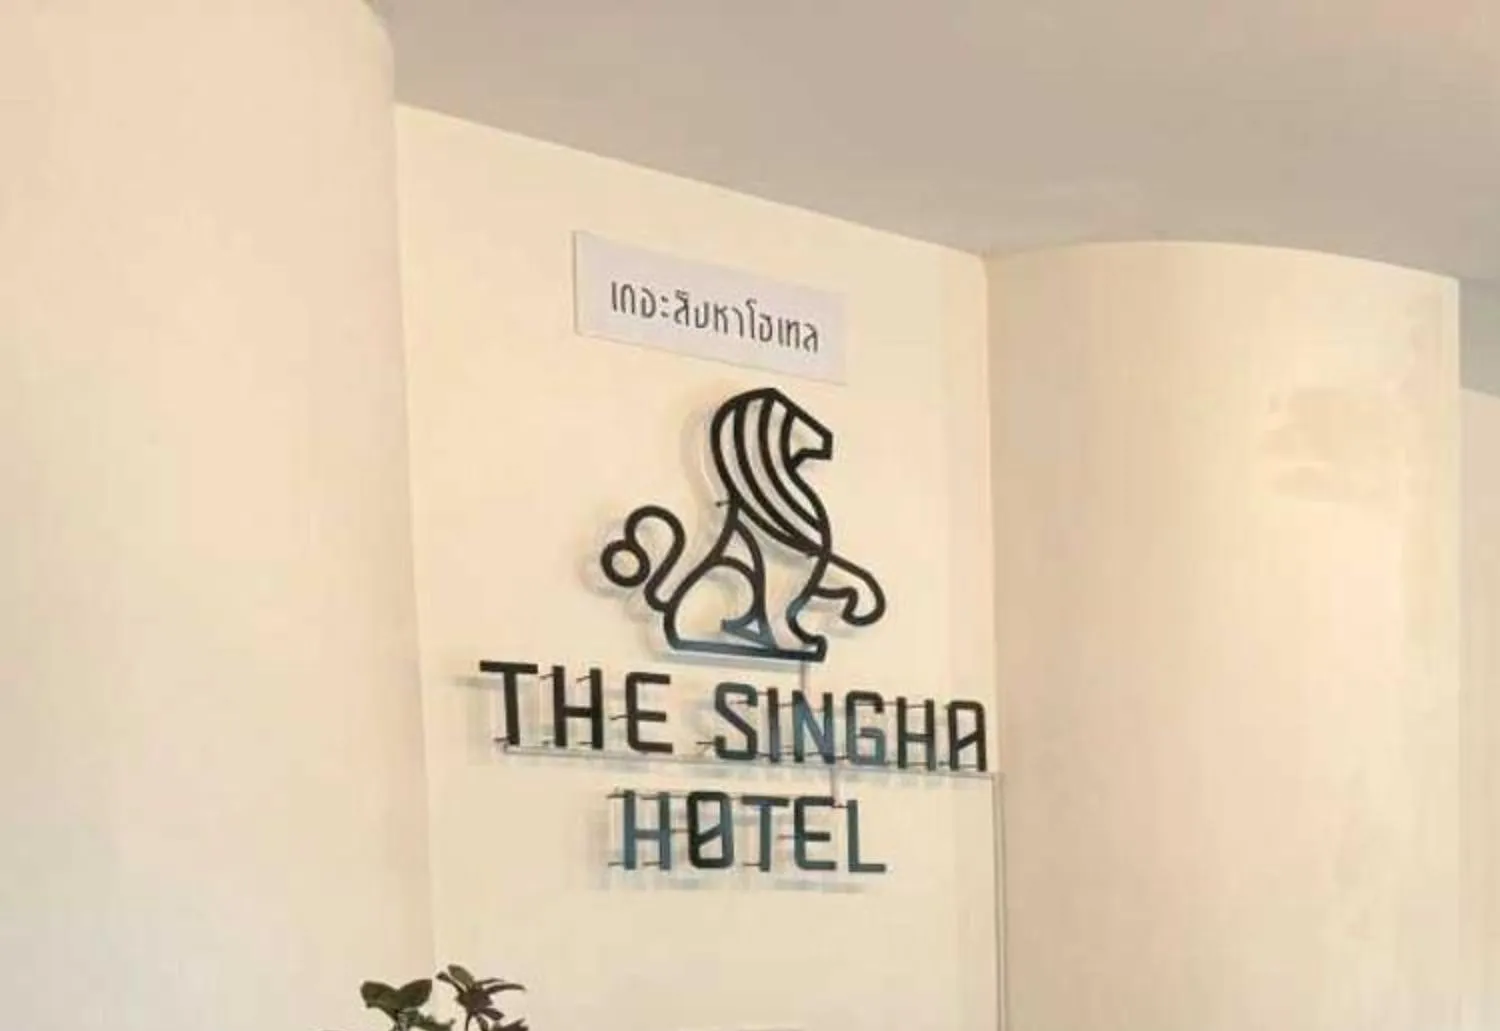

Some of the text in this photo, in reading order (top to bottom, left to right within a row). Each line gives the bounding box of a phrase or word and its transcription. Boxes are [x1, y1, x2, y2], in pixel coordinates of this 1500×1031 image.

[479, 660, 988, 773] THE SINGHA
[621, 790, 888, 874] HOTEL
